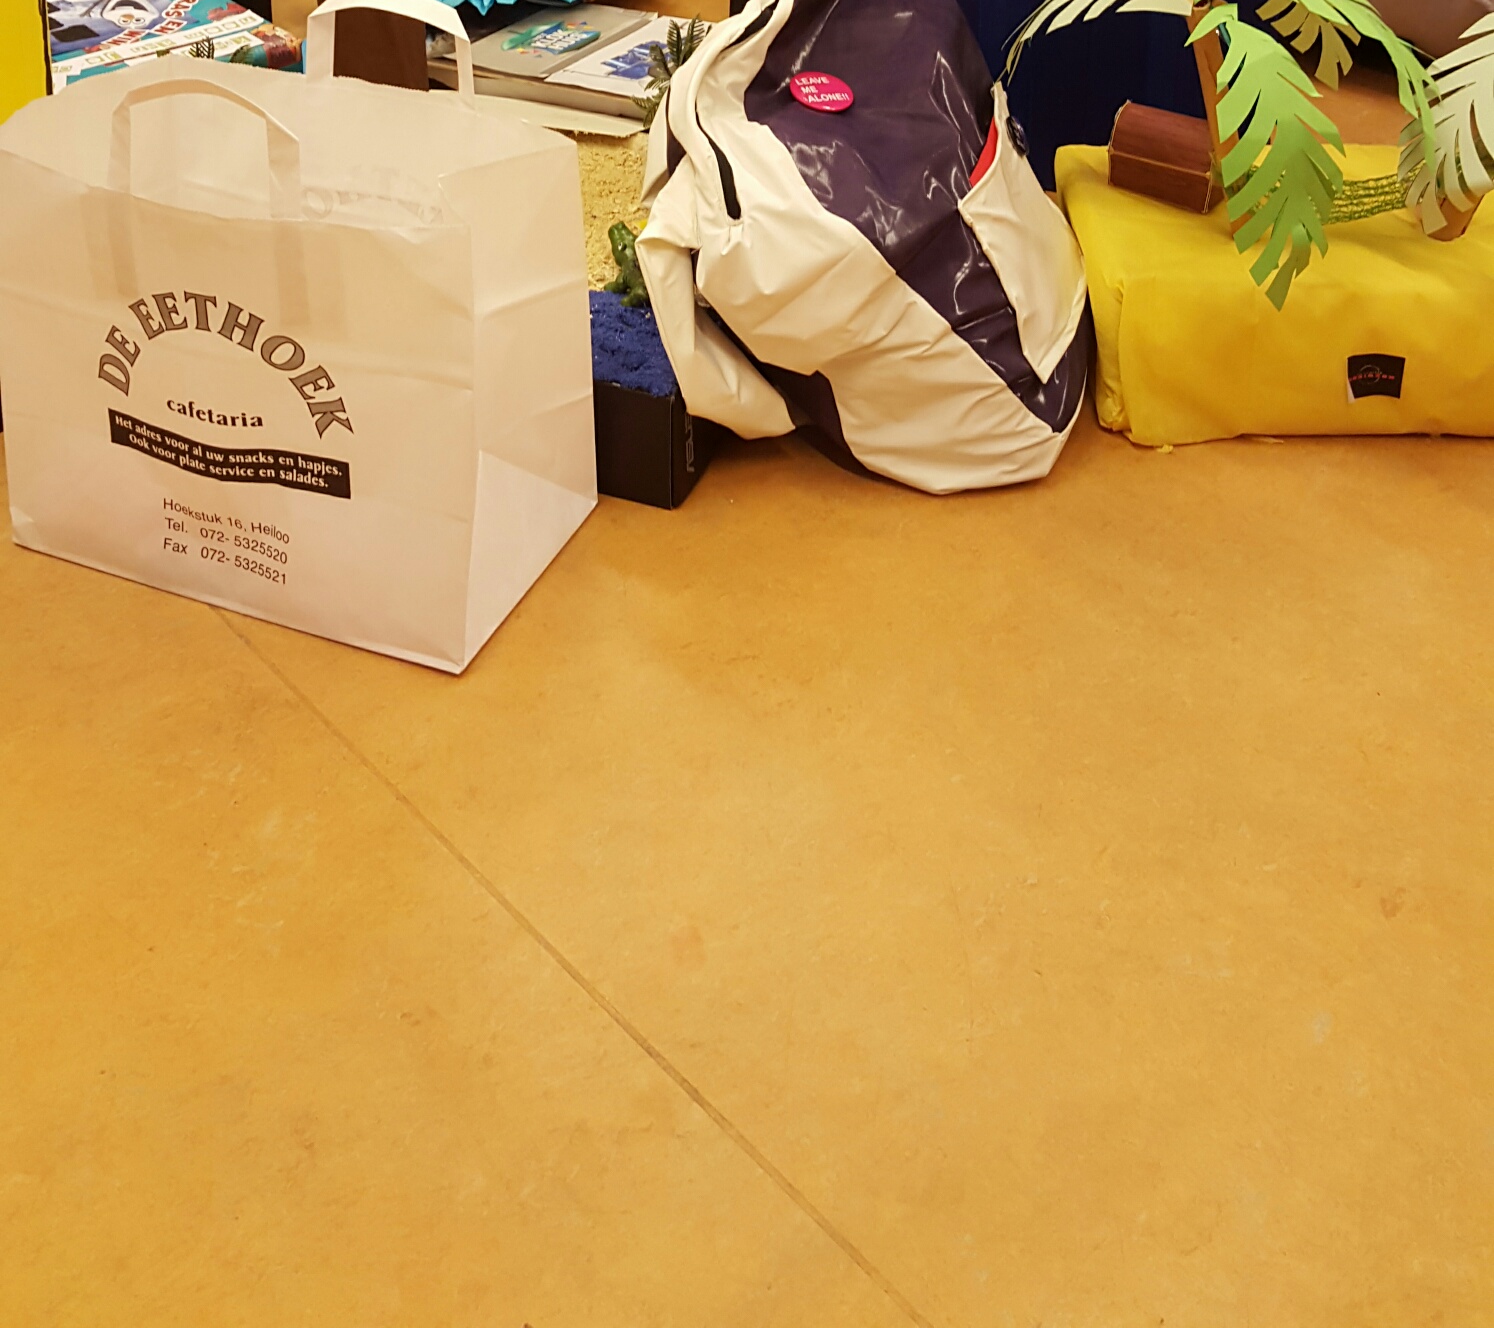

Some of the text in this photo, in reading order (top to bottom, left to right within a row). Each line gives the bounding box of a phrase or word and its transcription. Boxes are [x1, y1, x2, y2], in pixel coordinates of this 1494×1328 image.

[795, 76, 829, 86] LEAVE
[801, 85, 818, 94] ME
[98, 290, 354, 439] DE EETHOEK
[166, 399, 263, 427] cafetaria
[115, 415, 342, 476] Het adres voor al uw snacks en hapjes.
[129, 434, 329, 488] Ook voor plate service en salades.
[163, 497, 290, 545] Hoekstuk 16, Heiloo
[165, 517, 188, 533] Tel.
[234, 535, 288, 565] 5325520
[163, 537, 188, 555] Fax
[234, 555, 286, 585] 5325521
